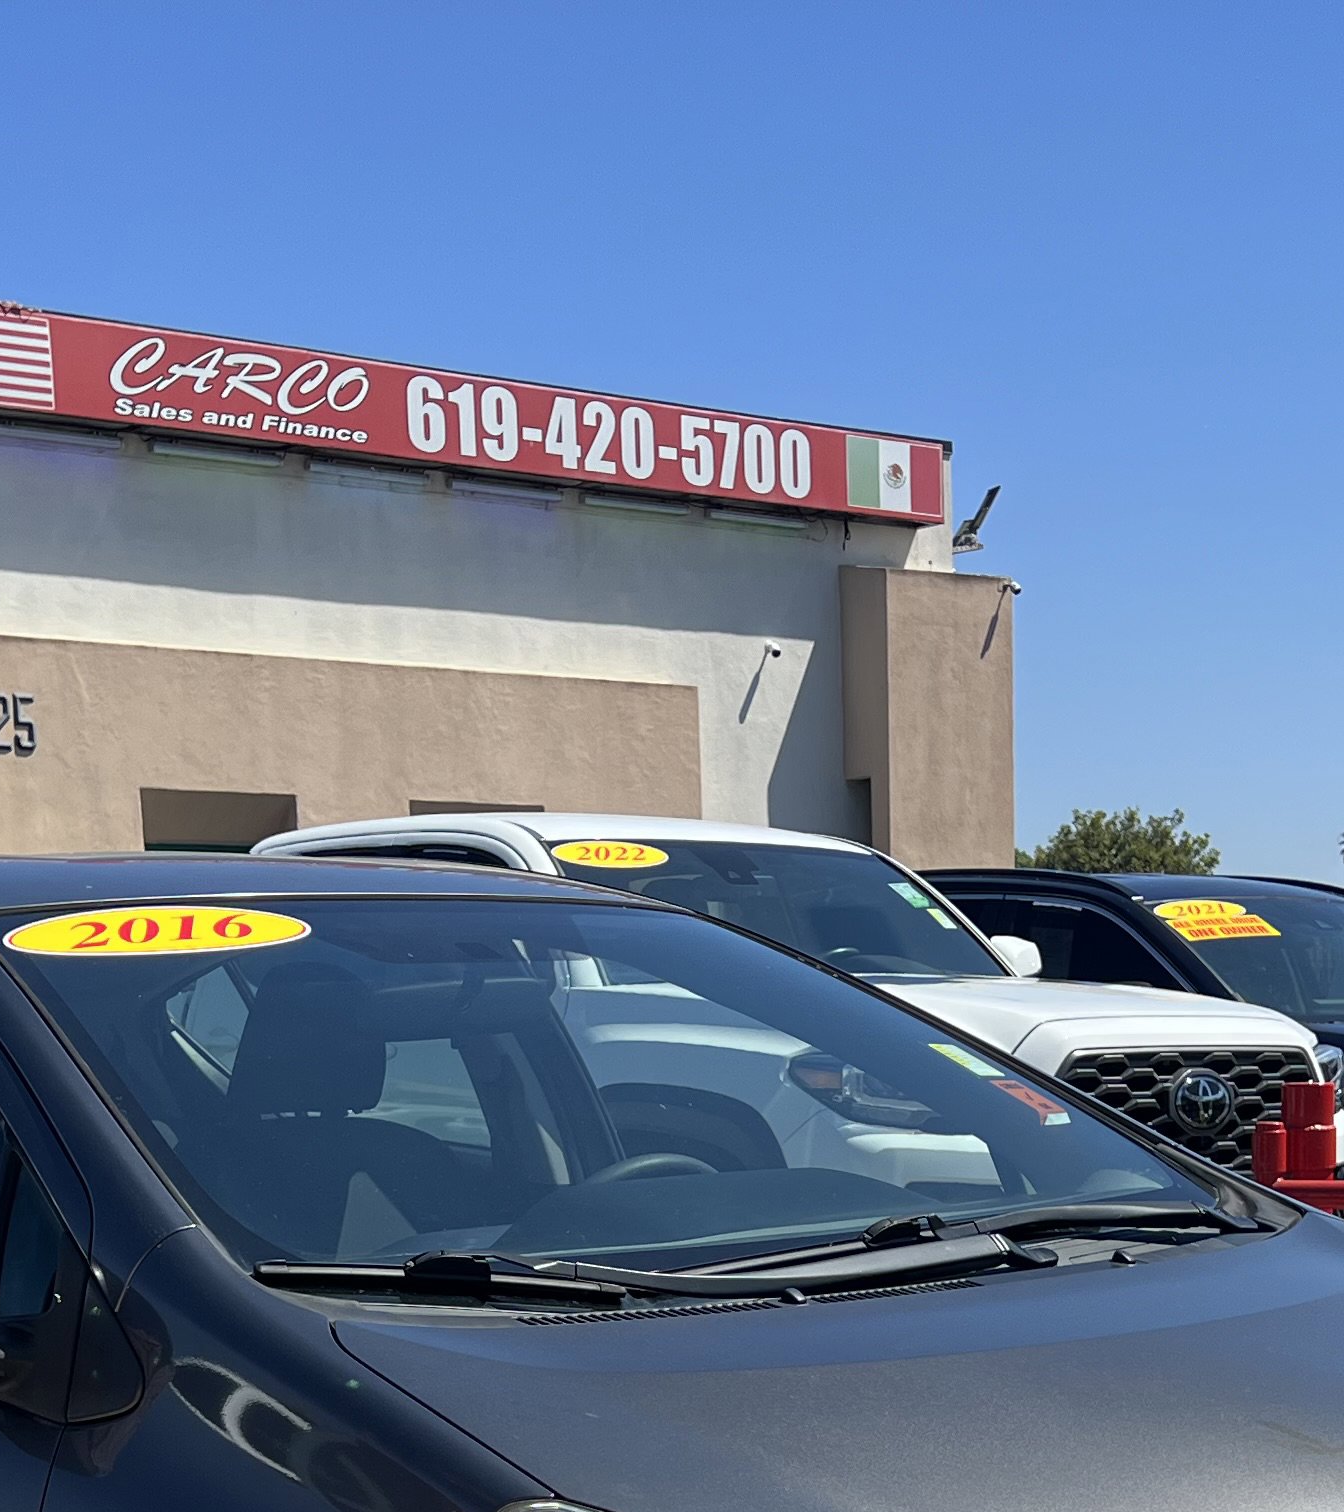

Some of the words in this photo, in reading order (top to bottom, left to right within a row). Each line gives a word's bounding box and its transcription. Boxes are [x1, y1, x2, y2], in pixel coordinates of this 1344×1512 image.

[108, 337, 371, 416] CARCO
[113, 398, 194, 423] Sales
[201, 409, 255, 431] and
[261, 415, 369, 444] Finance
[406, 375, 812, 500] 619-420-5700
[576, 846, 647, 862] 2022
[1172, 903, 1227, 917] 2021
[70, 913, 253, 950] 2016
[1188, 927, 1219, 938] ONE
[1219, 925, 1271, 936] OWNER
